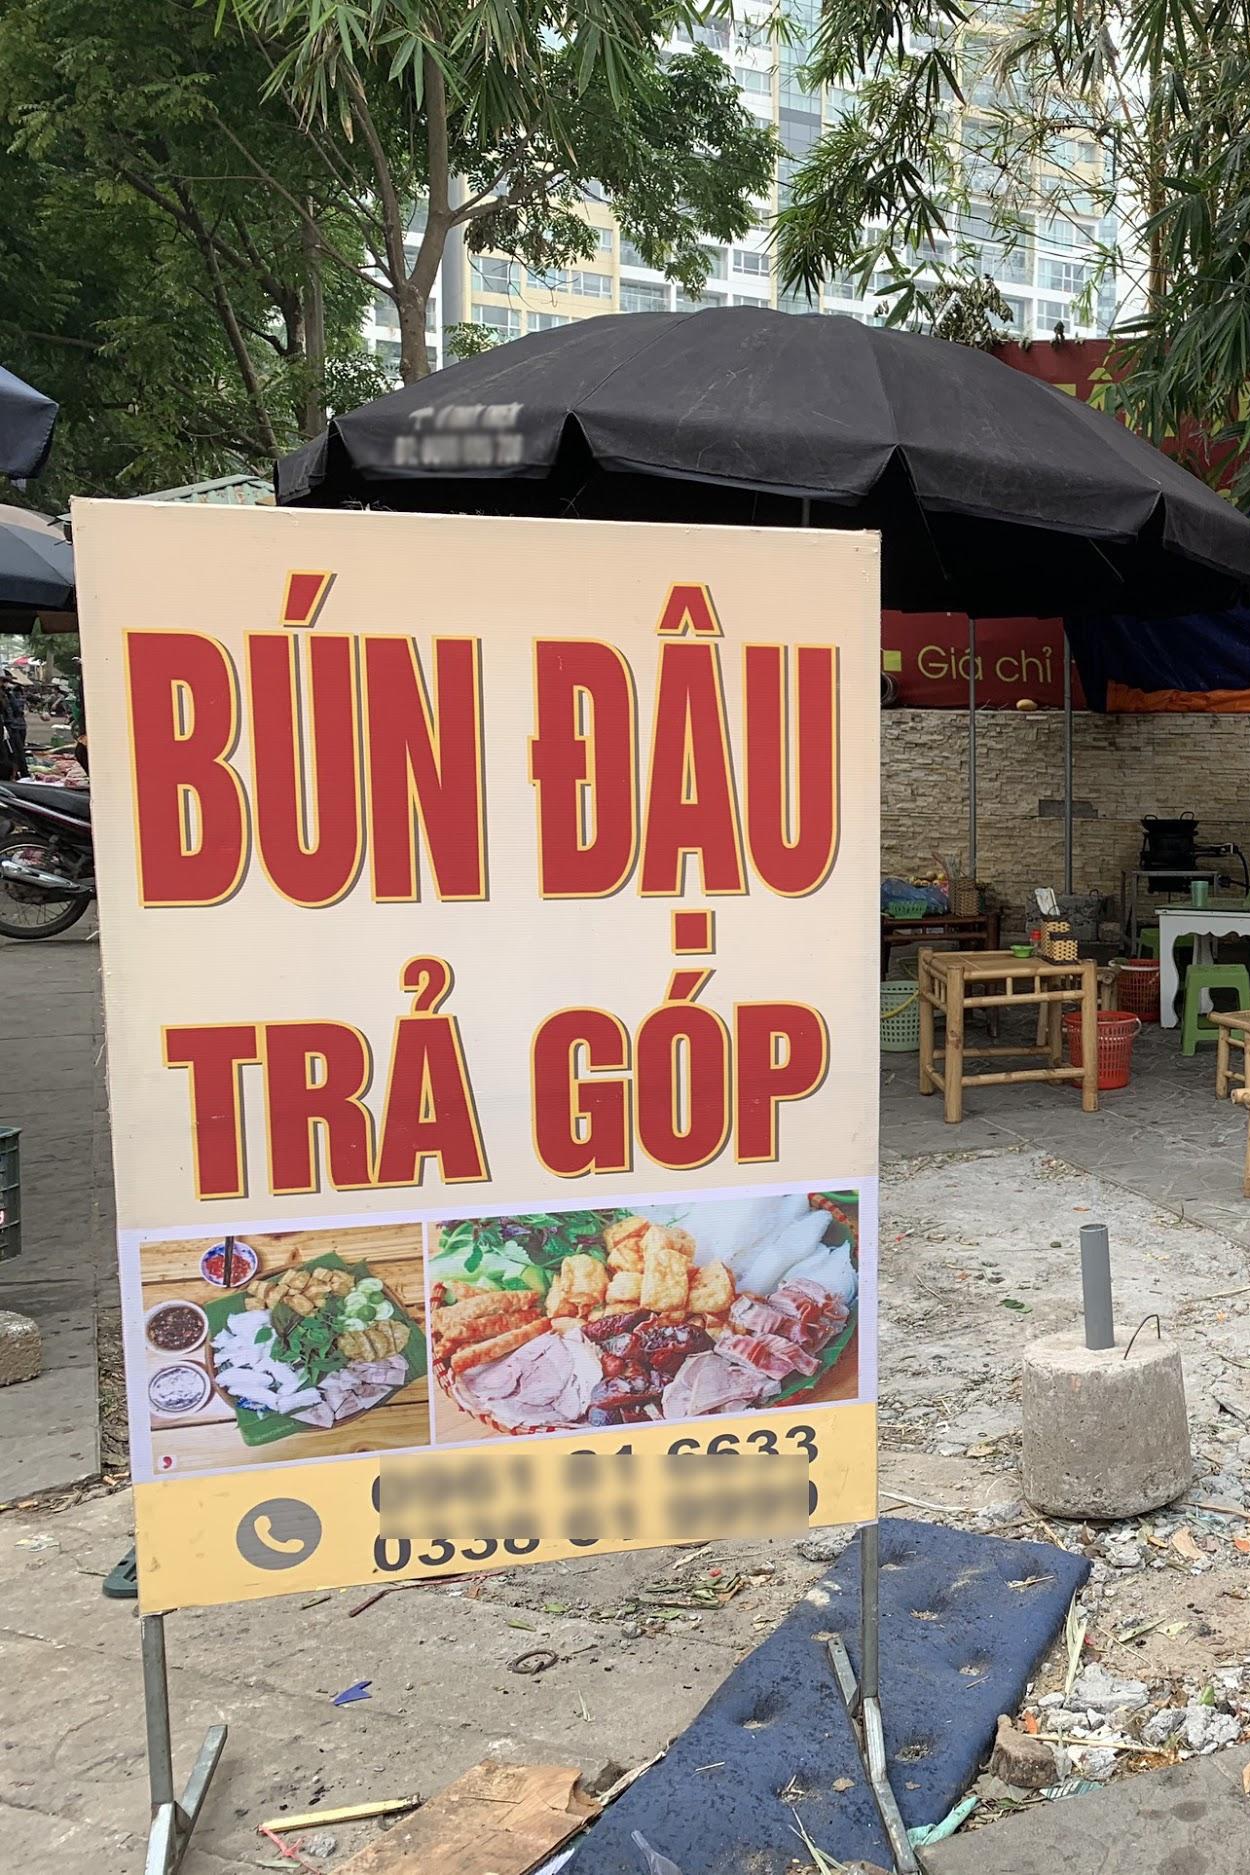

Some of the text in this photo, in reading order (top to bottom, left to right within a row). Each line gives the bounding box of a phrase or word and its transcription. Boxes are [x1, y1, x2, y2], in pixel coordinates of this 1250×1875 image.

[122, 569, 841, 955] BÚN ĐẬU
[917, 645, 1053, 684] Giá chỉ
[161, 955, 832, 1200] TRẢ GÓP
